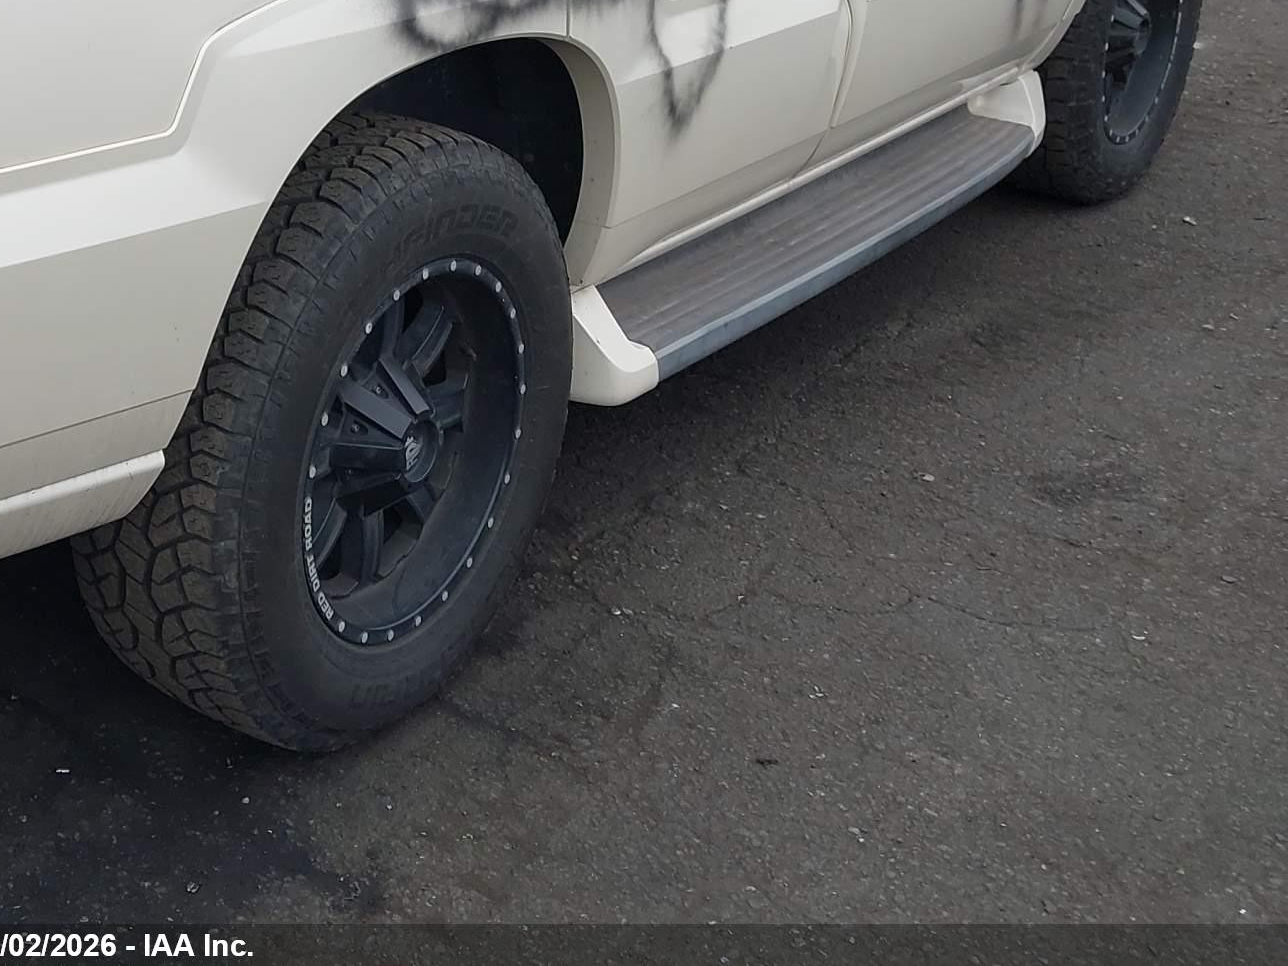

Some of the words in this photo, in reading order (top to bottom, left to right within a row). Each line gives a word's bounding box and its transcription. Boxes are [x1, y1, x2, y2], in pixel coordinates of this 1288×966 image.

[304, 496, 313, 552] ROAD
[306, 553, 321, 592] DIRT
[317, 591, 334, 621] RED
